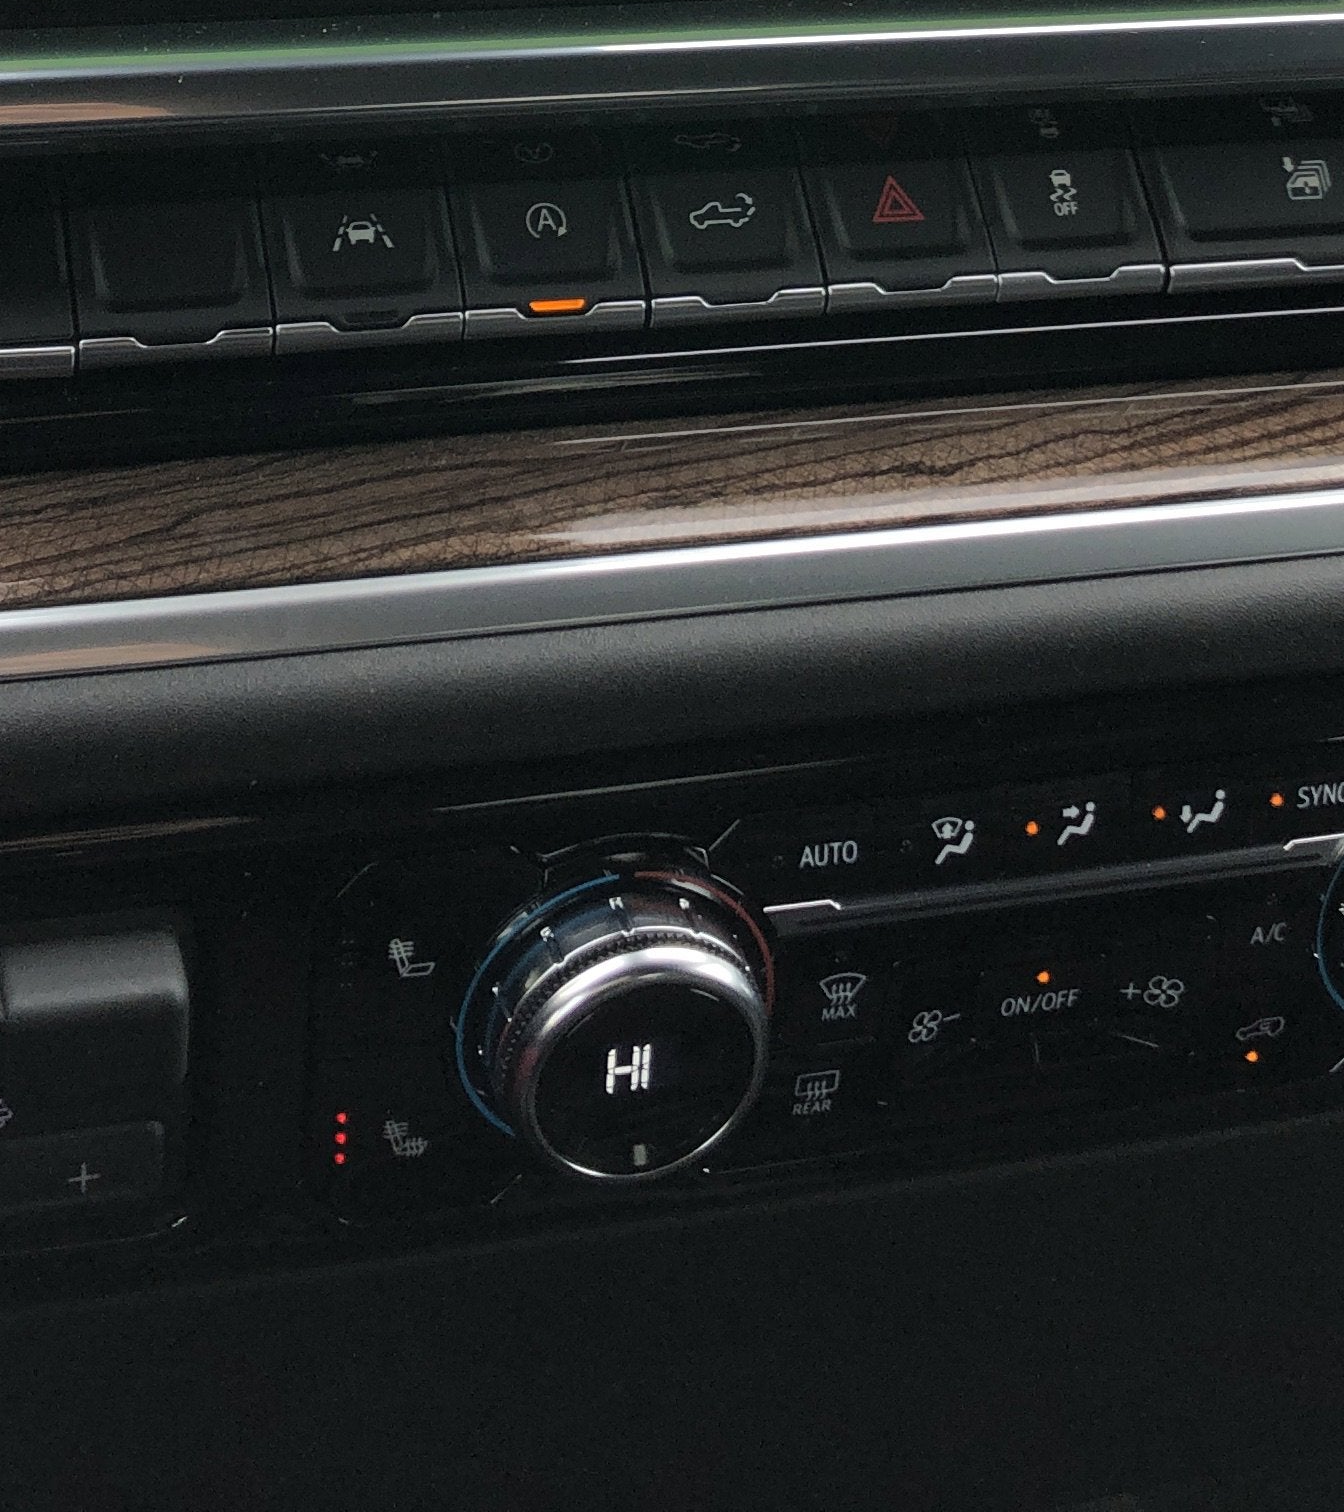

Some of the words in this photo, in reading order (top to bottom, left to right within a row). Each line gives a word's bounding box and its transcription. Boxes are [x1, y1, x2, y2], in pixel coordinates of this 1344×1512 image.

[1053, 201, 1079, 217] OFF
[799, 840, 859, 869] AUTO
[1250, 922, 1288, 945] A/C
[821, 1002, 857, 1021] MAX
[1000, 988, 1080, 1018] ON/OFF
[604, 1042, 653, 1095] HI
[792, 1098, 833, 1116] REAR
